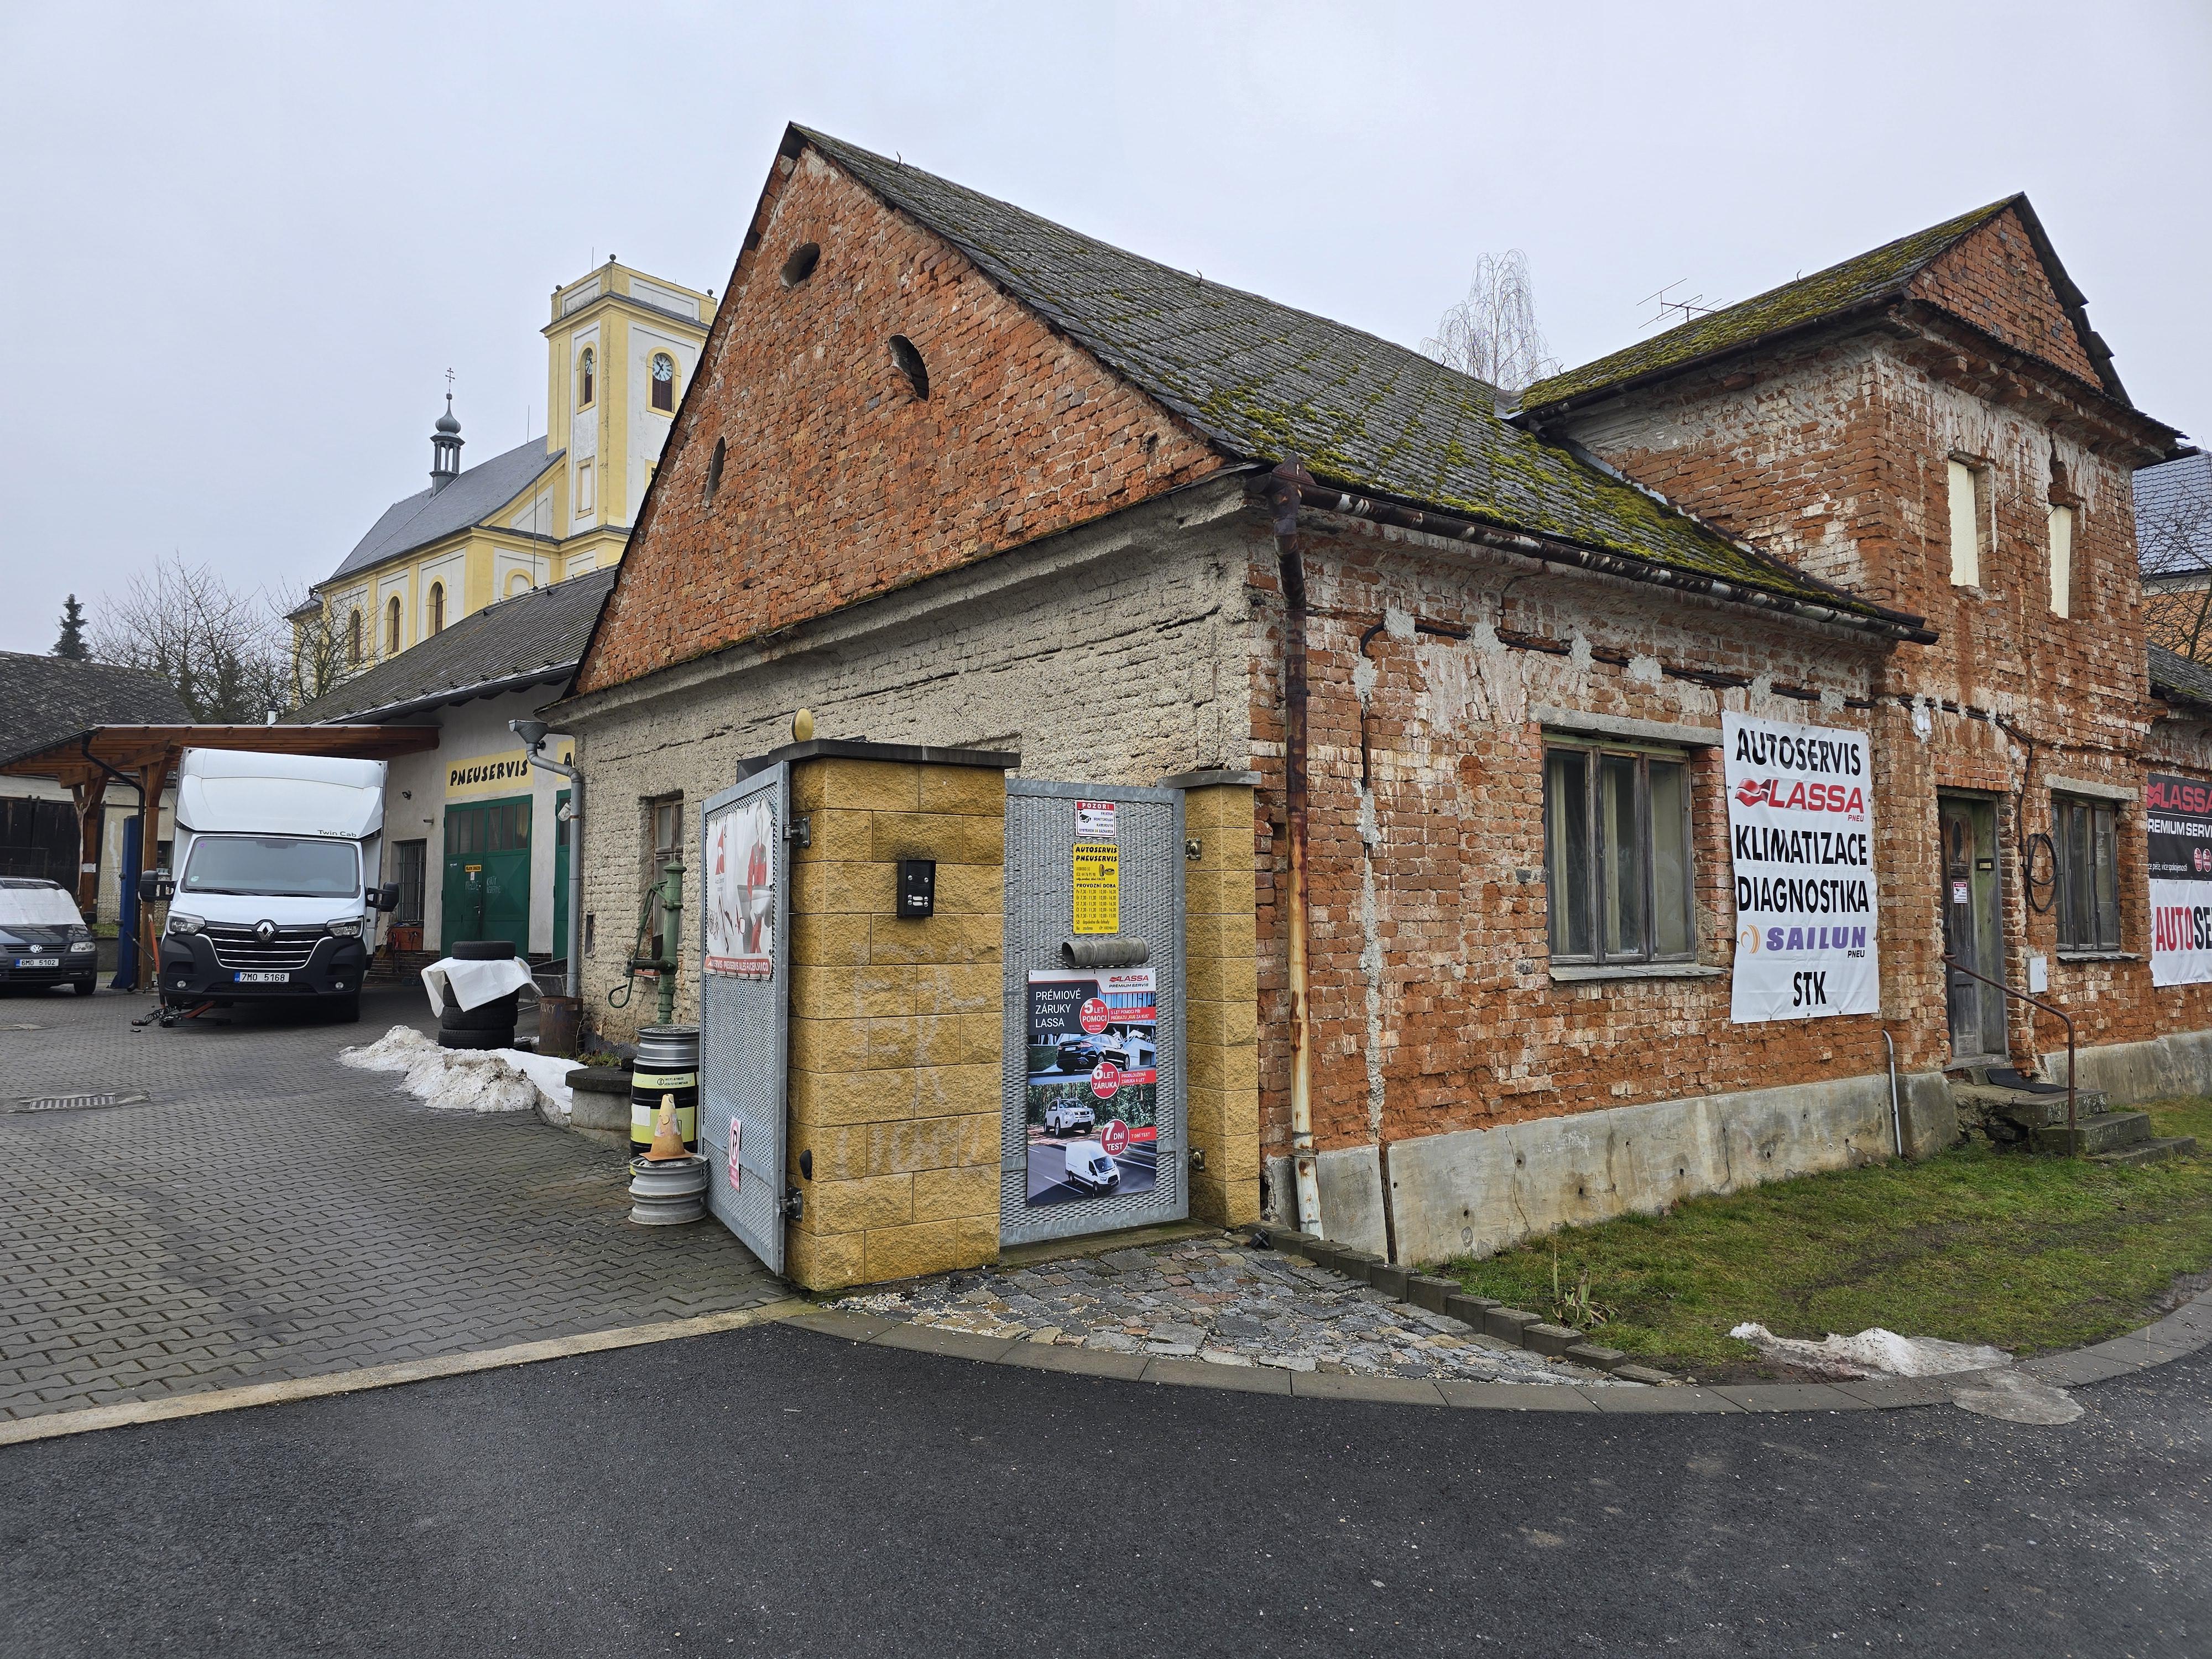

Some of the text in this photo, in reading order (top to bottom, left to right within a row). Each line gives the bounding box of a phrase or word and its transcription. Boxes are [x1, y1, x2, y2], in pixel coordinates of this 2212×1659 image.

[564, 752, 576, 768] A
[1736, 728, 1861, 776] AUTOSERVIS
[450, 759, 528, 786] PNEUSERVIS
[1768, 779, 1864, 813] LASSA
[2147, 818, 2185, 836] REMIUM
[1735, 825, 1867, 865] KLIMATIZACE
[1738, 876, 1869, 914] DIAGNOSTIKA
[2156, 906, 2212, 951] AUTOSE
[1766, 926, 1866, 951] SAILUN
[264, 973, 285, 982] 5168
[1035, 988, 1081, 1001] PRÉMIOVÉ
[1793, 971, 1827, 1006] STK
[1035, 1002, 1071, 1014] ZÁRUKY
[1084, 1000, 1093, 1014] 5
[1035, 1018, 1065, 1028] LASSA
[1093, 1065, 1103, 1079] 6
[1093, 1081, 1117, 1089] ZÁRUKA
[1105, 1122, 1125, 1141] 7 DNÍ
[1107, 1142, 1124, 1151] TEST
